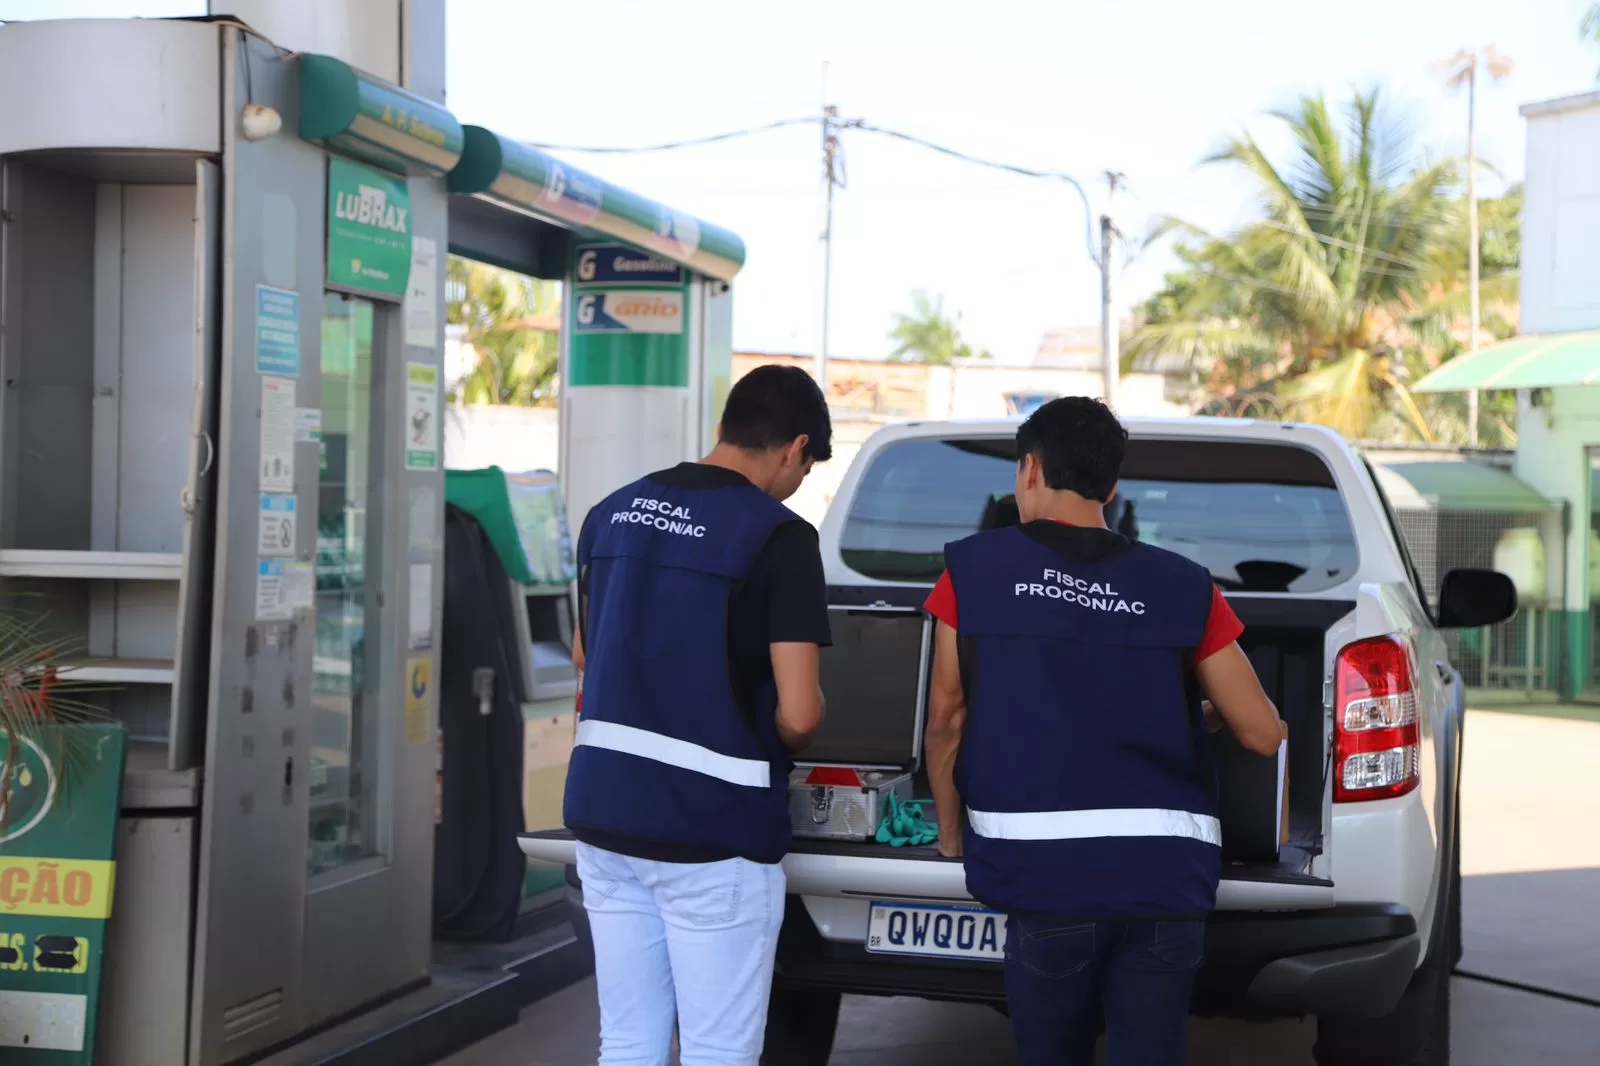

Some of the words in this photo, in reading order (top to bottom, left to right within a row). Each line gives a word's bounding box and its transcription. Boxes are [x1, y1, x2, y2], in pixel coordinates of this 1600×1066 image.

[335, 184, 407, 233] LUBRAX
[578, 250, 597, 280] G
[577, 294, 596, 324] G
[632, 498, 692, 520] FISCAL
[611, 511, 706, 538] PROCON/AC
[1043, 568, 1119, 596] FISCAL
[1015, 583, 1145, 615] PROCON/AC
[0, 862, 93, 910] ÇÃO
[888, 910, 1008, 952] QWQ0A
